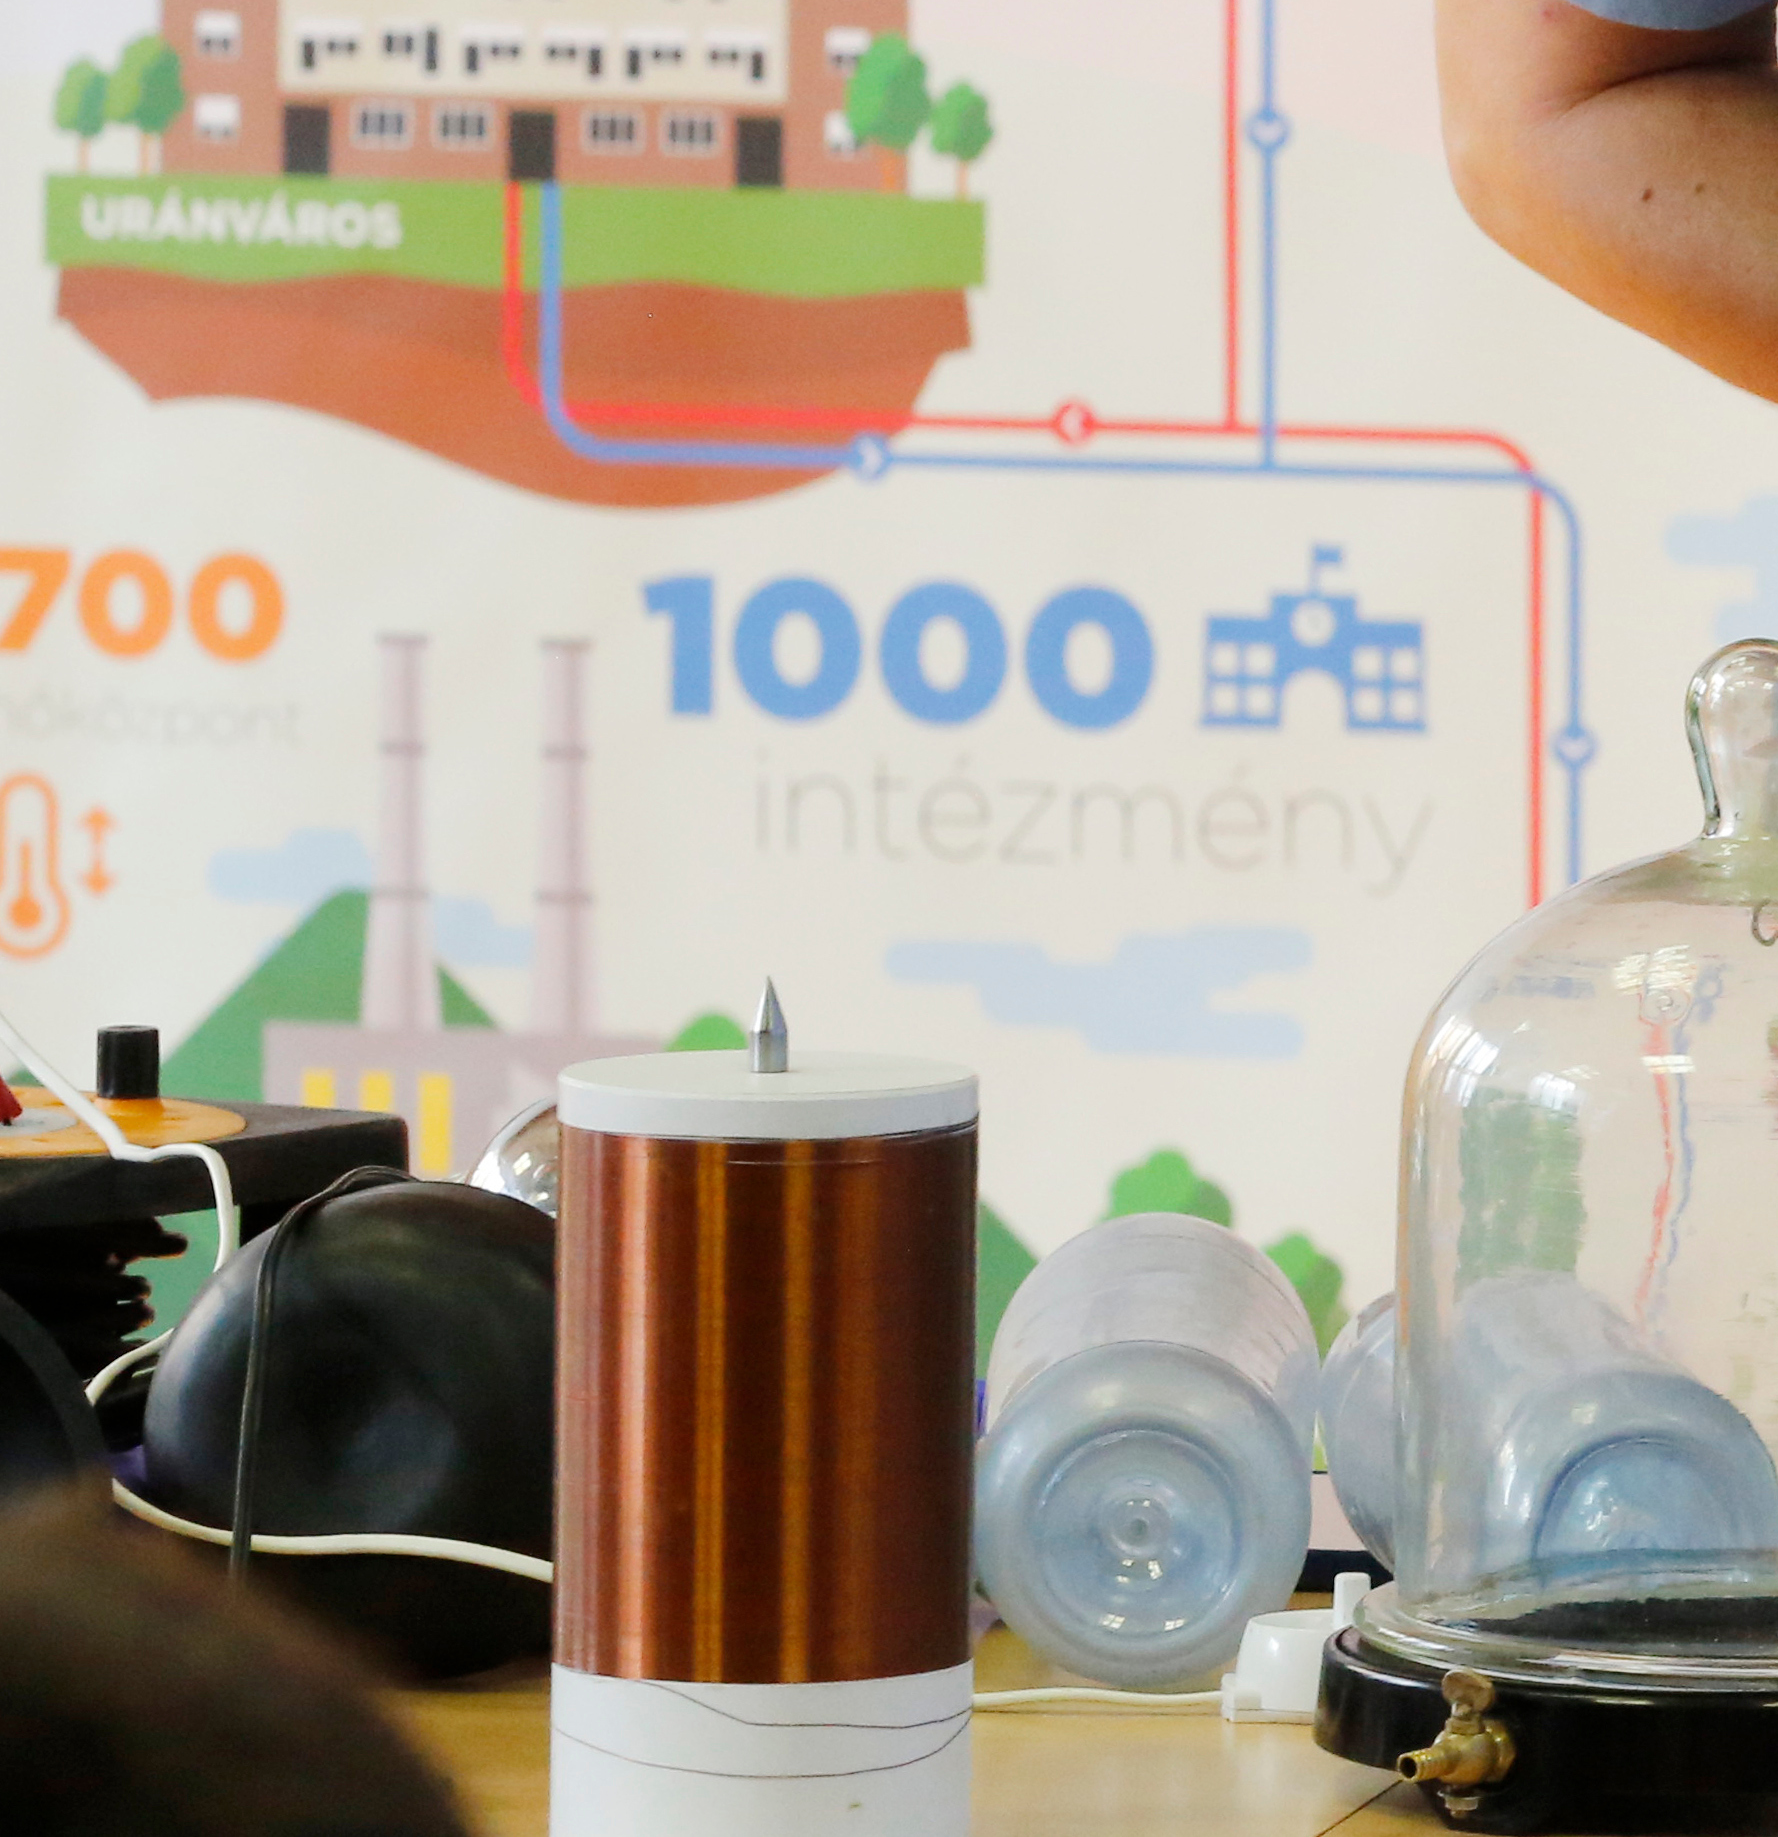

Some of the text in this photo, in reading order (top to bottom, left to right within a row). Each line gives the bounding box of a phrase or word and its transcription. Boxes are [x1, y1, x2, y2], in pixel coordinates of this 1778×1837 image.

[81, 189, 402, 249] URÁNVÁROS
[0, 544, 288, 664] 700
[642, 574, 1157, 732] 1000
[753, 746, 1437, 900] intézmény
